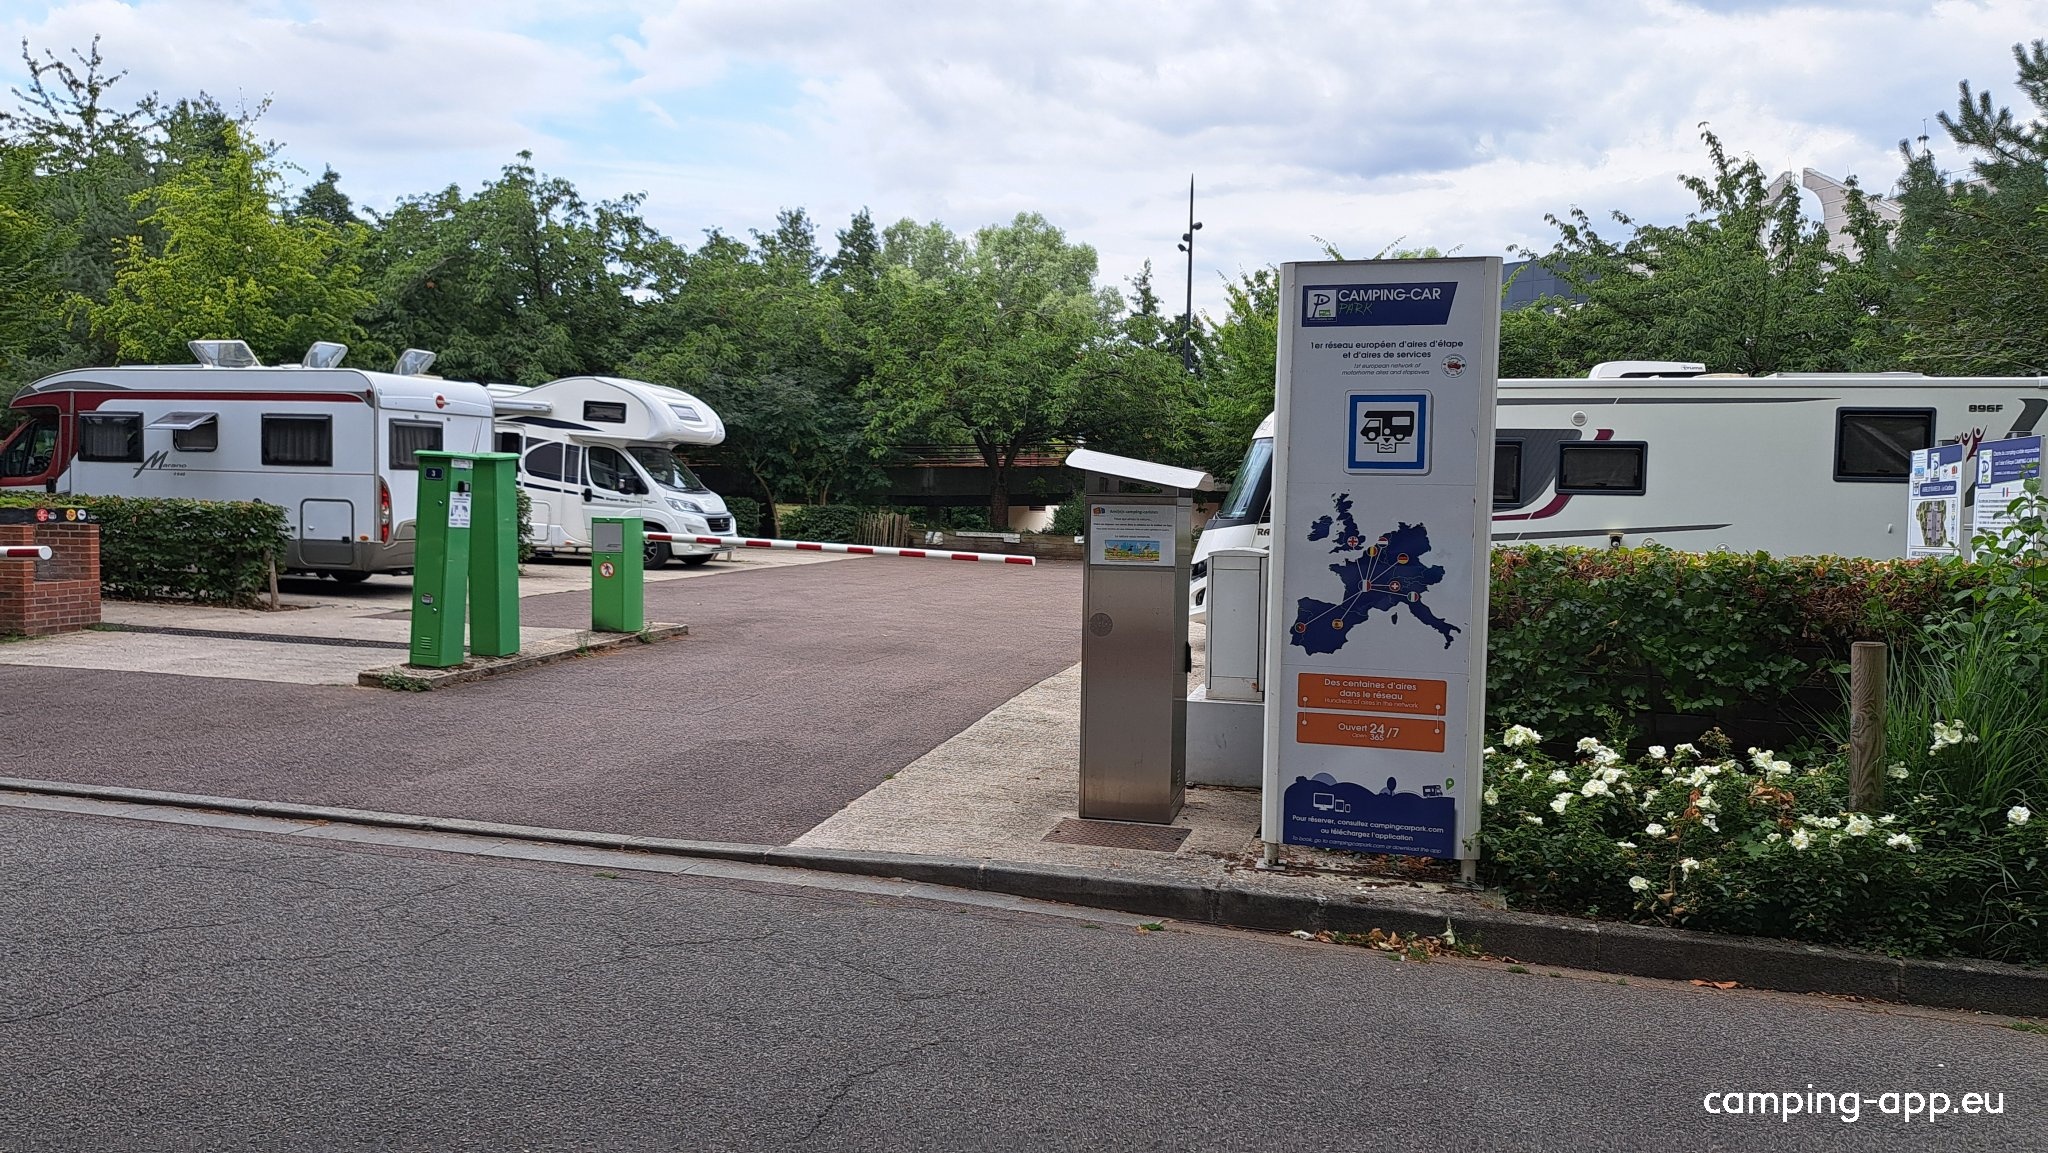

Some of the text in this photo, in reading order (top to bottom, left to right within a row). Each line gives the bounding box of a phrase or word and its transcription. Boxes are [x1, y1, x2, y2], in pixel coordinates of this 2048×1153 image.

[1338, 287, 1441, 302] CAMPING-CAR
[1339, 303, 1373, 316] PARK
[1311, 339, 1464, 351] 1er réseau européen d'aires d'étape
[1342, 350, 1432, 359] et d'aires de services
[1968, 404, 2004, 413] 896F
[431, 469, 436, 477] 3
[1324, 678, 1417, 691] Des centaines d'aires
[1339, 689, 1403, 700] dans le réseau
[1338, 722, 1368, 732] Ouvert
[1292, 814, 1444, 834] Pour réserver, consultez campingcarpark.com
[1330, 828, 1370, 839] téléchargez
[1371, 832, 1414, 842] l'application
